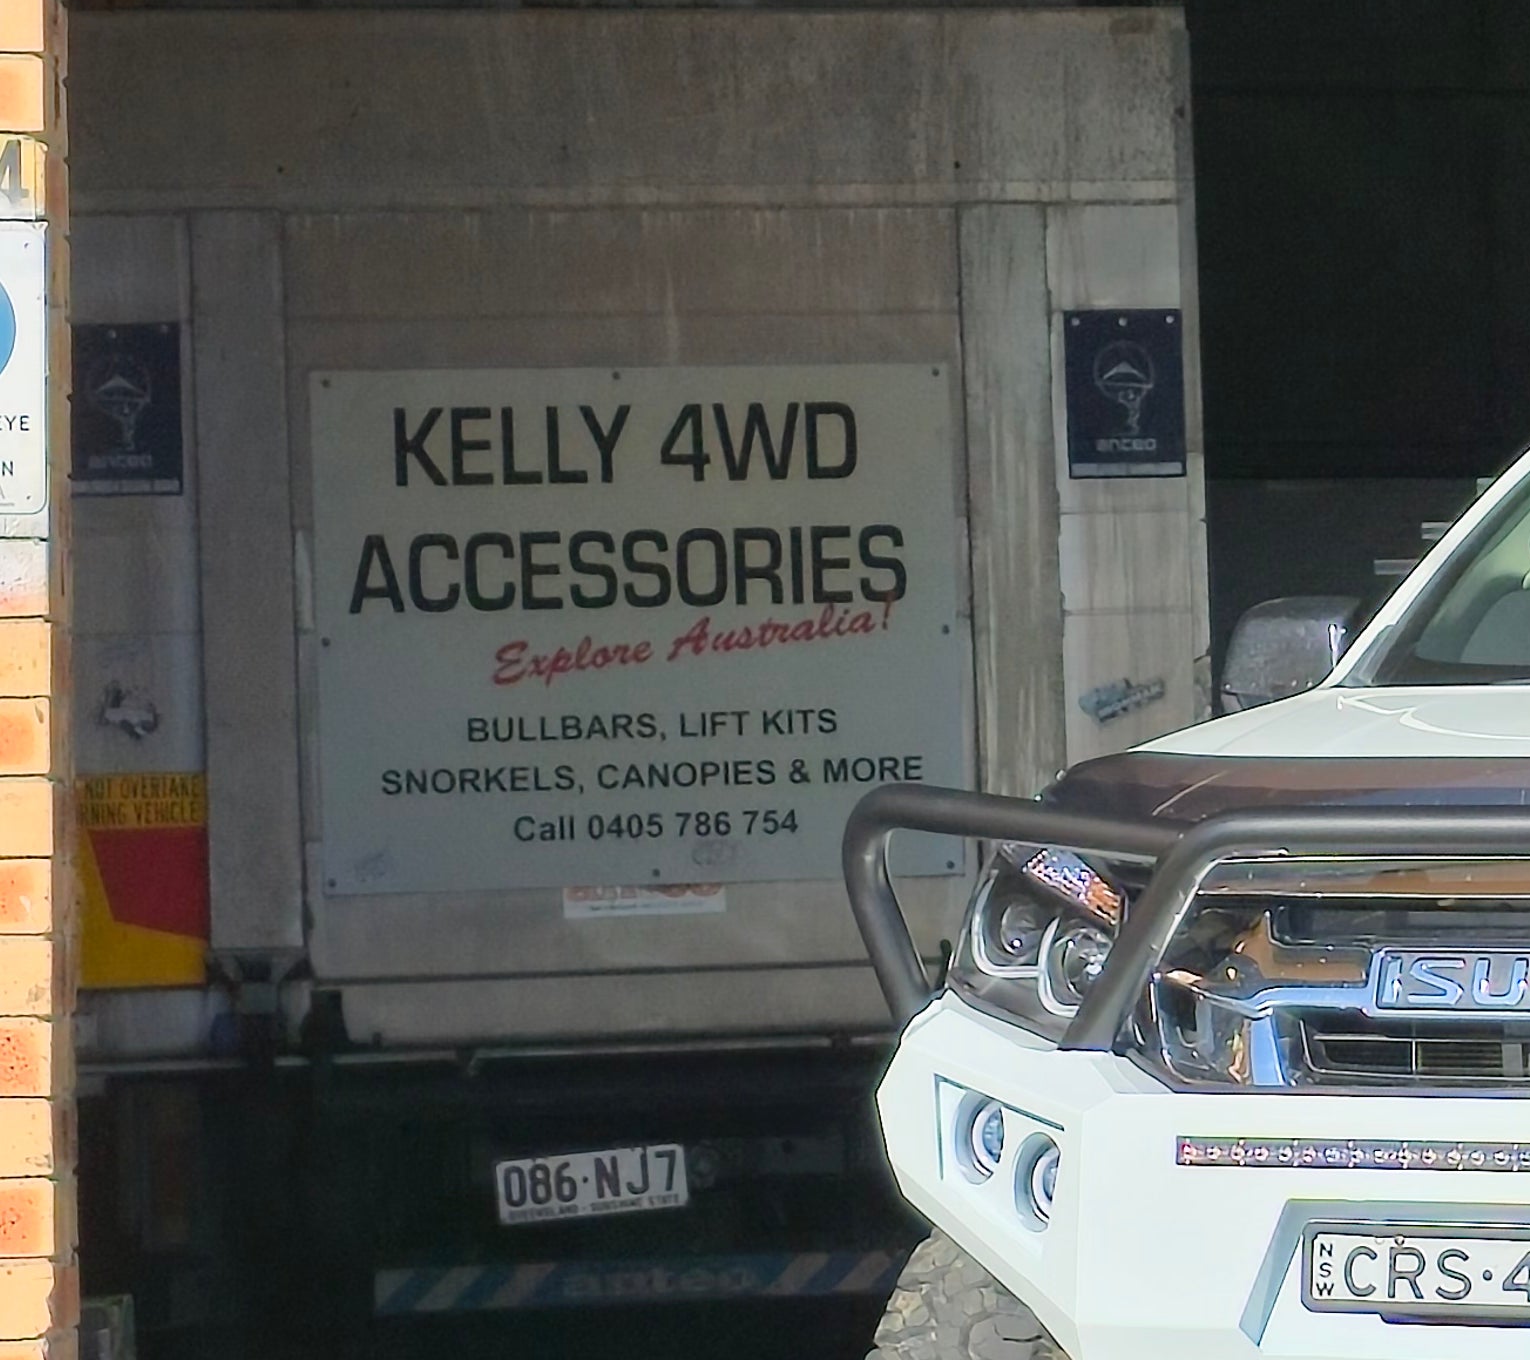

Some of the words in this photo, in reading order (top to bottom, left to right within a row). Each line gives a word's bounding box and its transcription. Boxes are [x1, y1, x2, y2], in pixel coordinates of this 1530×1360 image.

[0, 415, 30, 431] YE
[393, 404, 631, 487] KELLY
[660, 401, 858, 482] 4WD
[349, 524, 907, 614] ACCESSORIES
[491, 641, 654, 688] Explore
[668, 595, 896, 662] Australia!
[467, 713, 667, 743] BULLBARS,
[680, 711, 750, 738] LIFT
[762, 708, 838, 735] KITS
[381, 765, 584, 796] SNORKELS,
[598, 760, 776, 791] CANOPIES
[789, 759, 811, 785] &
[823, 756, 924, 783] MORE
[514, 814, 575, 843] Call
[587, 813, 663, 840] 0405
[676, 811, 731, 837] 786
[743, 809, 798, 834] 754
